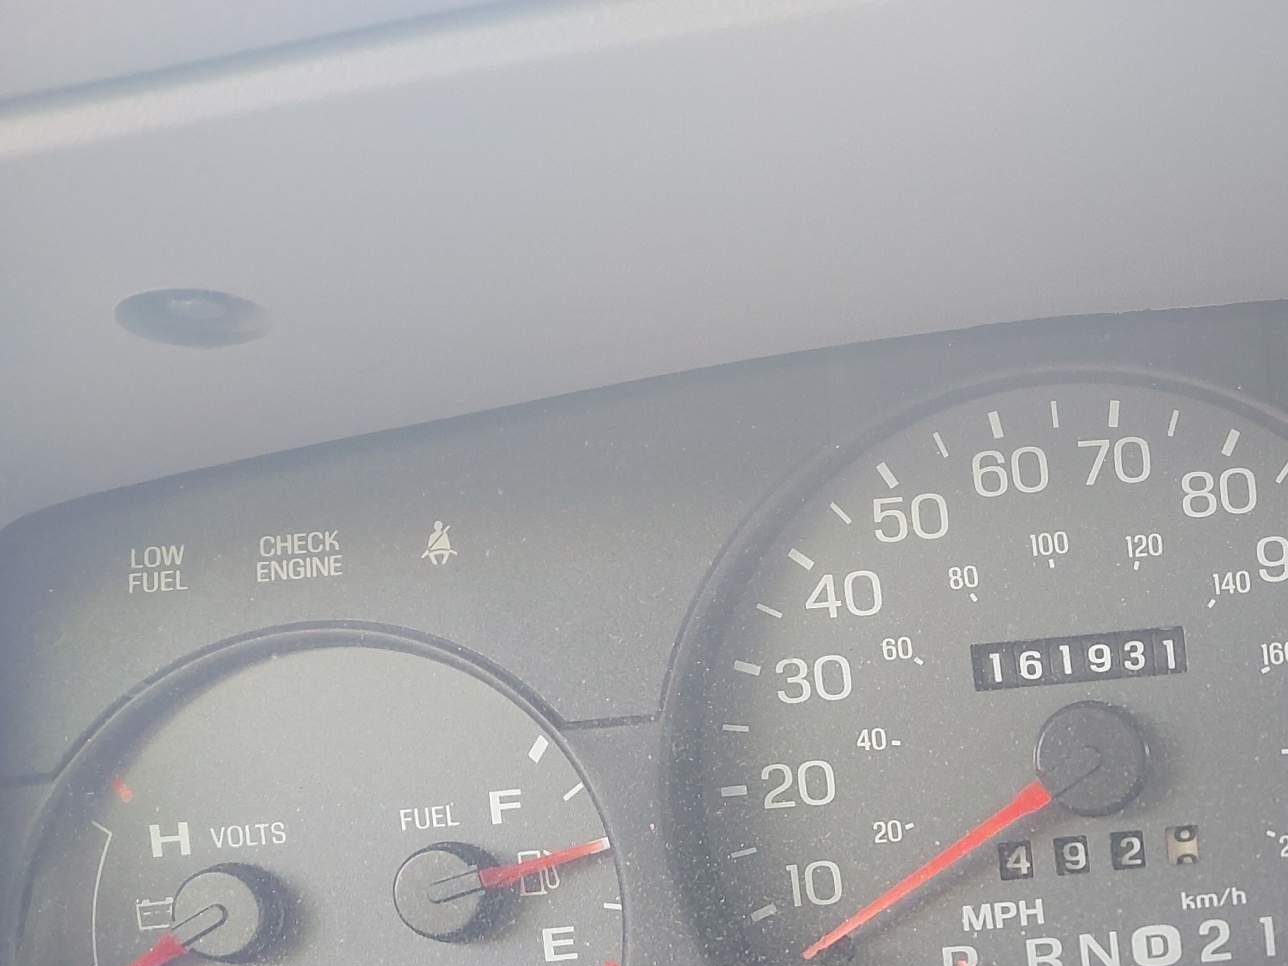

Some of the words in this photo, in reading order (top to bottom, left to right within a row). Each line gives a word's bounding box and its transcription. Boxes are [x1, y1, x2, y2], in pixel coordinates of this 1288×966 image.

[971, 446, 1048, 497] 60
[1078, 436, 1151, 485] 70
[1181, 467, 1257, 518] 80
[873, 493, 948, 543] 50
[130, 544, 185, 568] LOW
[259, 530, 340, 557] CHECK
[1030, 531, 1069, 556] 100
[1125, 533, 1163, 558] 120
[128, 570, 188, 593] FUEL
[256, 555, 343, 582] ENGINE
[948, 565, 978, 590] 80
[1212, 570, 1250, 595] 140
[805, 571, 882, 617] 40
[882, 636, 913, 661] 60
[989, 639, 1176, 683] 161931
[775, 654, 852, 703] 30
[857, 728, 887, 751] 40
[761, 760, 835, 809] 20
[400, 804, 458, 831] FUEL
[488, 788, 522, 824] F
[149, 822, 190, 857] H
[210, 822, 286, 848] VOLTS
[873, 820, 902, 844] 20
[786, 861, 842, 907] 10
[1181, 887, 1247, 910] km/h
[962, 899, 1044, 931] MPH
[542, 926, 577, 962] E
[1199, 919, 1232, 963] 2
[1259, 916, 1276, 956] 1
